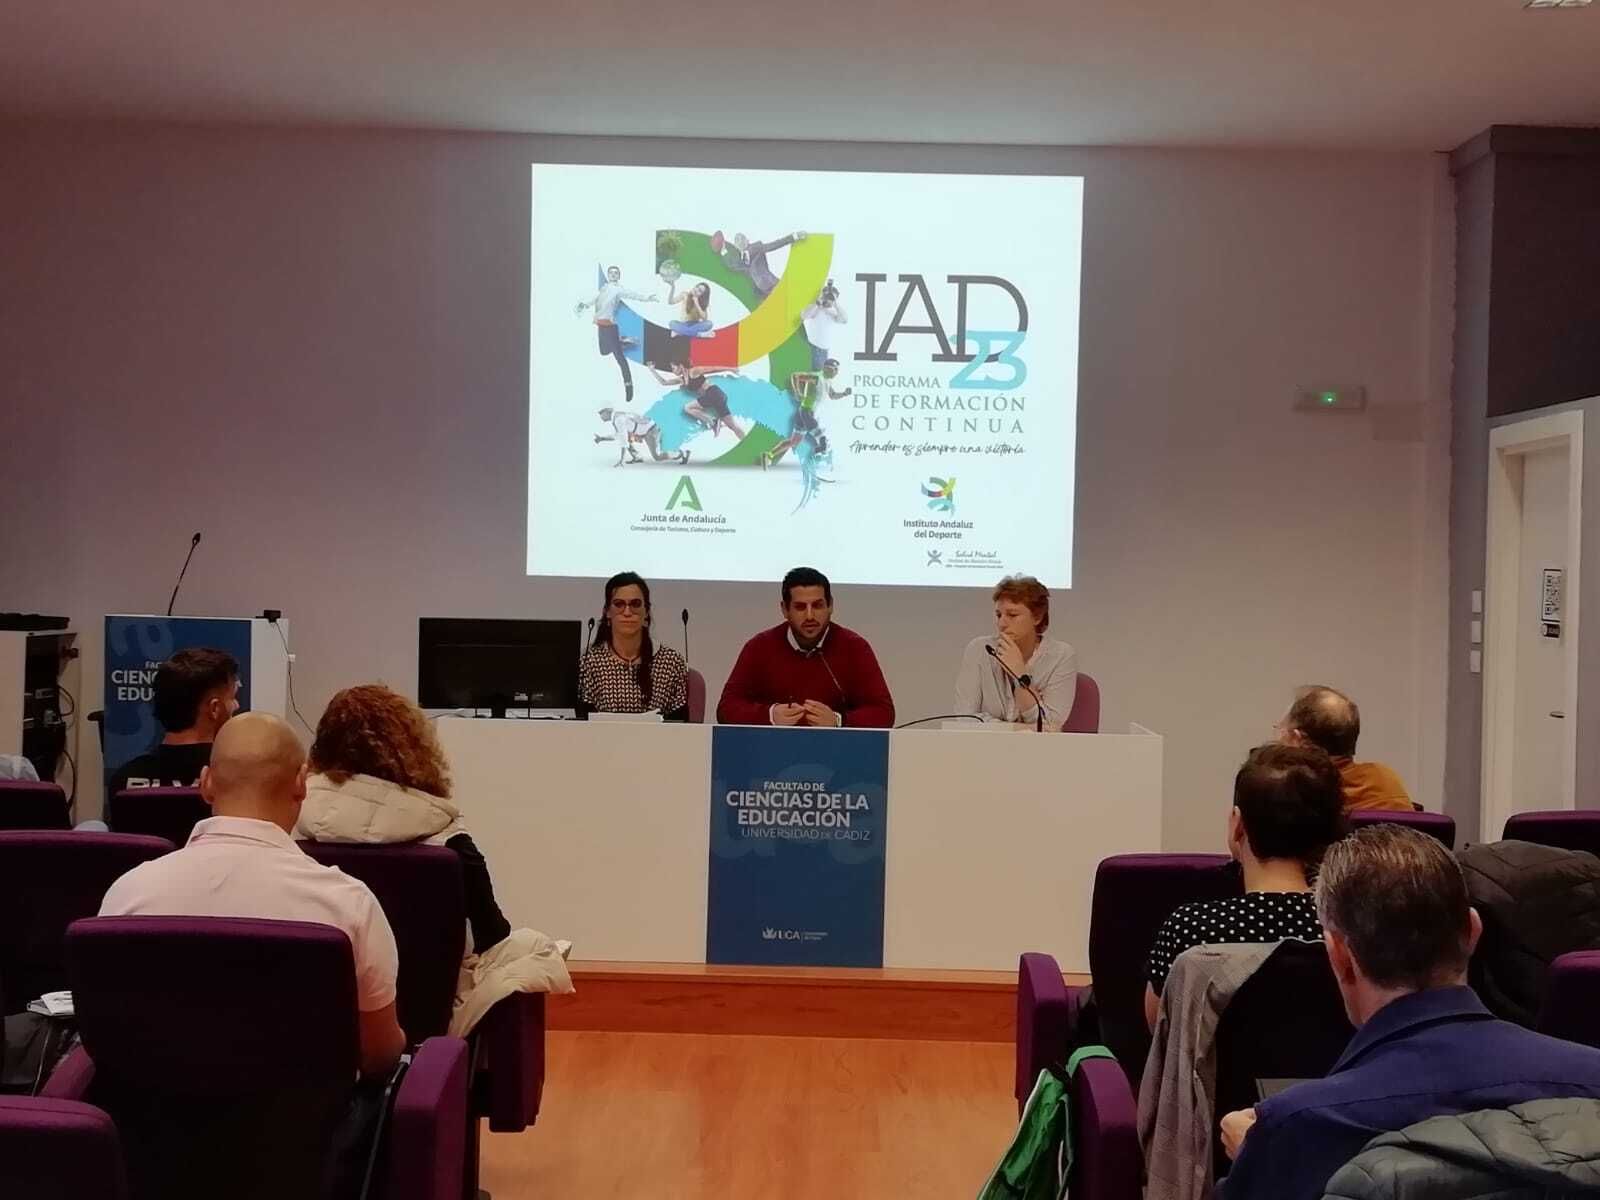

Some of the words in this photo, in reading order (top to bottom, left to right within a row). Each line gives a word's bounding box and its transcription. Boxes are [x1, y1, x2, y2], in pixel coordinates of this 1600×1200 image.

[853, 273, 1029, 363] IAD
[949, 330, 1028, 391] 23
[853, 375, 941, 389] PROGRAMA
[853, 394, 881, 409] DE
[890, 393, 1026, 411] FORMACIÓN
[851, 415, 1025, 434] CONTINUA
[849, 440, 901, 454] Aprender
[914, 442, 957, 457] siempre
[959, 445, 982, 454] una
[984, 442, 1024, 455] victoria
[641, 513, 667, 523] Junta
[669, 514, 681, 523] de
[682, 514, 727, 524] Andalucía
[903, 519, 938, 528] Instituto
[940, 520, 974, 529] Andaluz
[914, 530, 927, 538] del
[929, 530, 962, 540] Deporte
[111, 669, 159, 685] CIEN
[764, 781, 811, 791] FACULTAD
[812, 782, 825, 792] DE
[726, 790, 813, 808] CIENCIAS
[817, 793, 842, 809] DE
[846, 794, 870, 810] LA
[738, 808, 850, 828] EDUCACIÓN
[742, 828, 819, 840] UNIVERSIDAD
